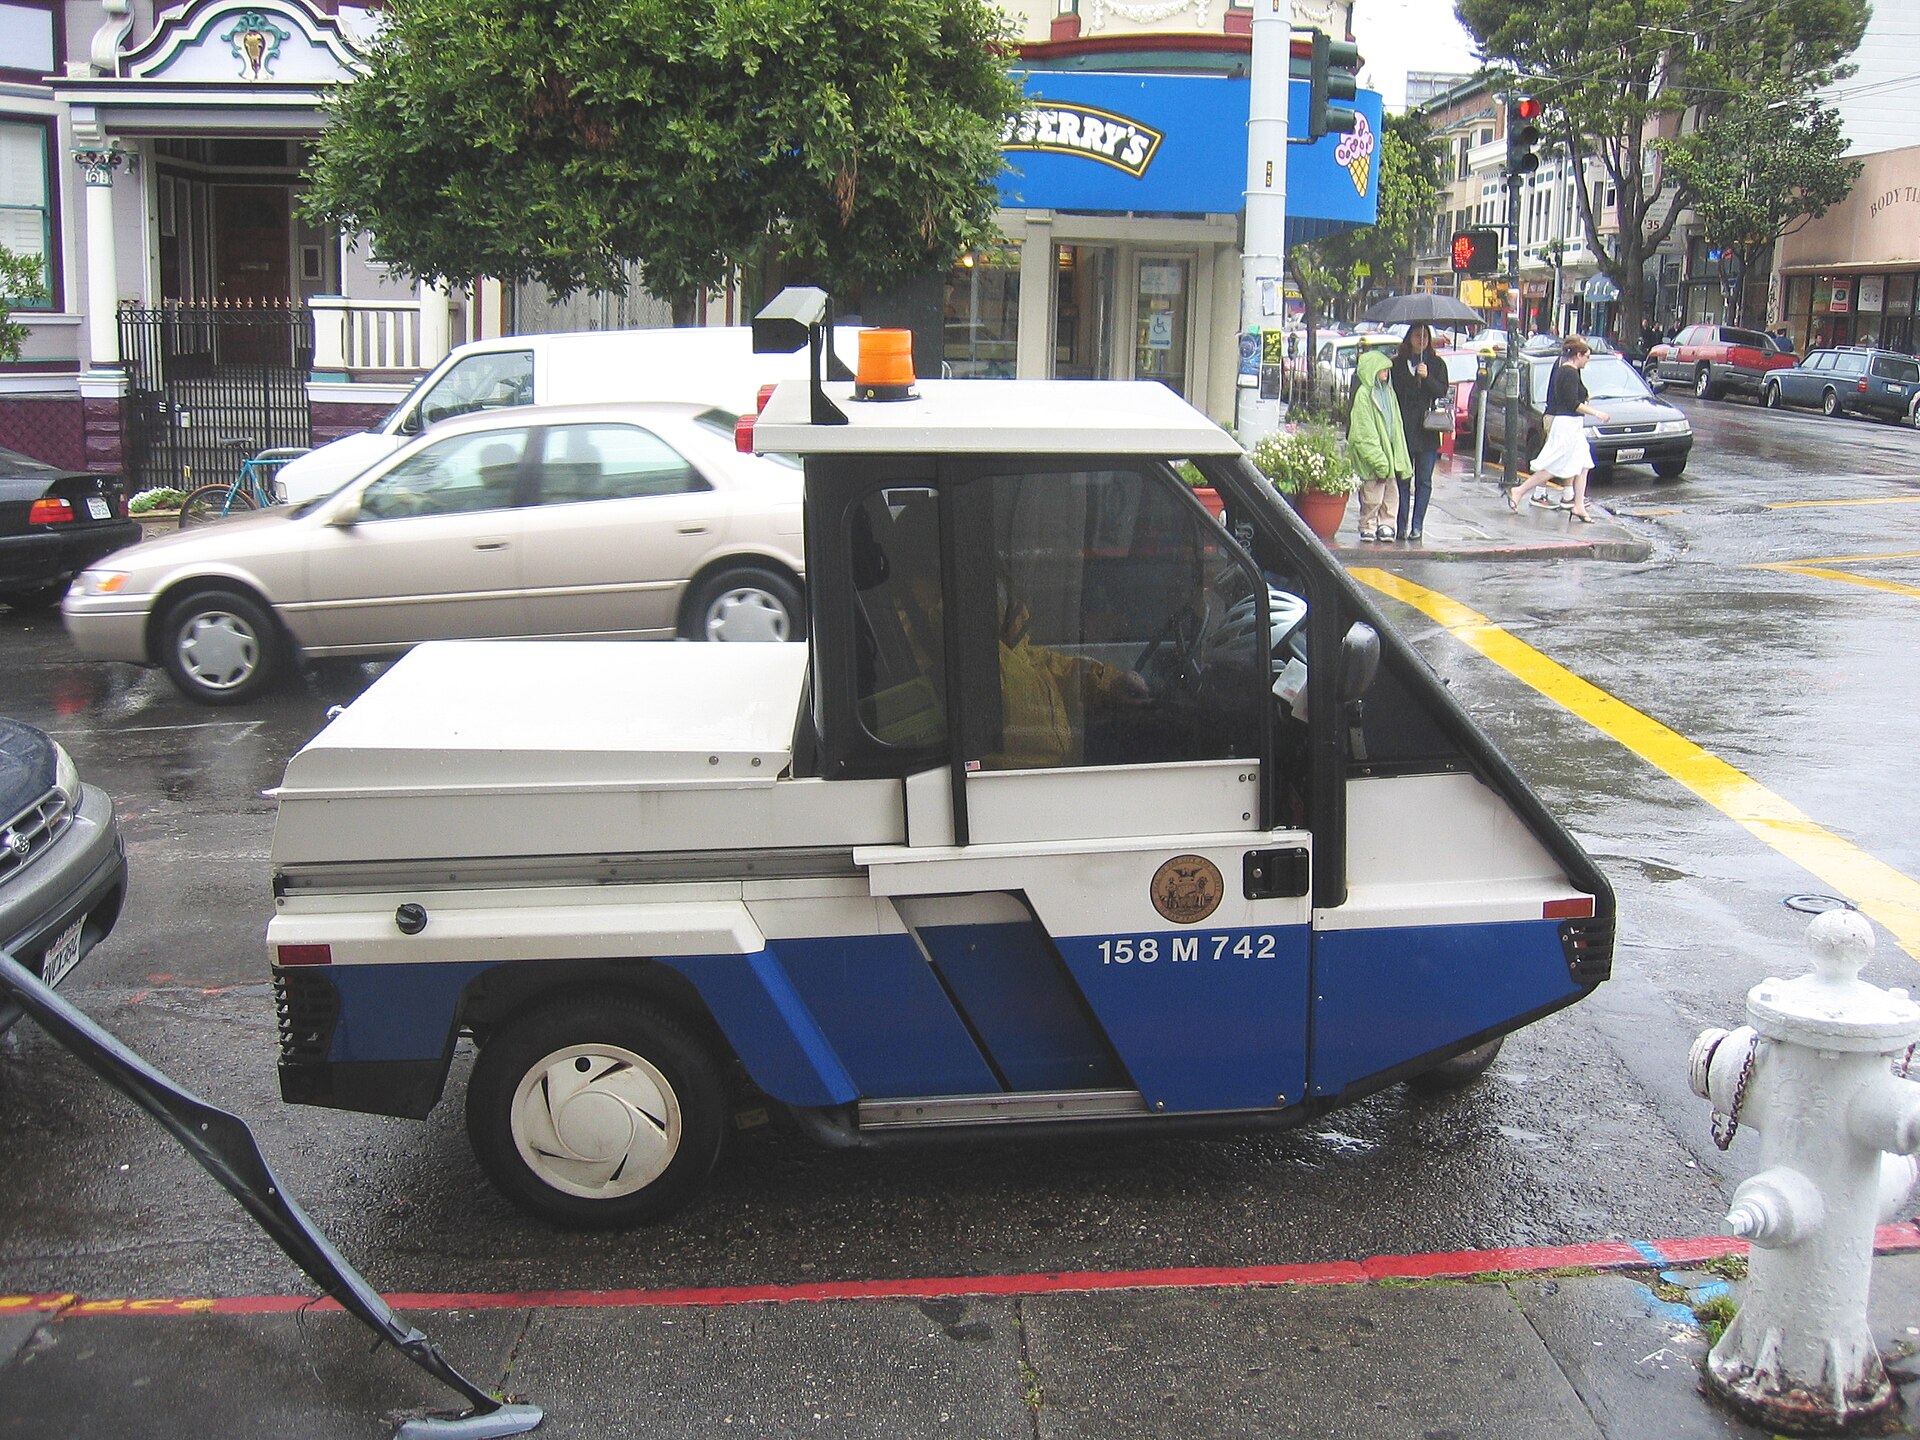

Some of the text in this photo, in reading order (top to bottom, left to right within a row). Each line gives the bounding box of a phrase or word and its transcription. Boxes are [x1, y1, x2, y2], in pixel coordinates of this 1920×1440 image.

[1870, 186, 1920, 219] BODY TI
[1098, 934, 1276, 964] 158 M 742
